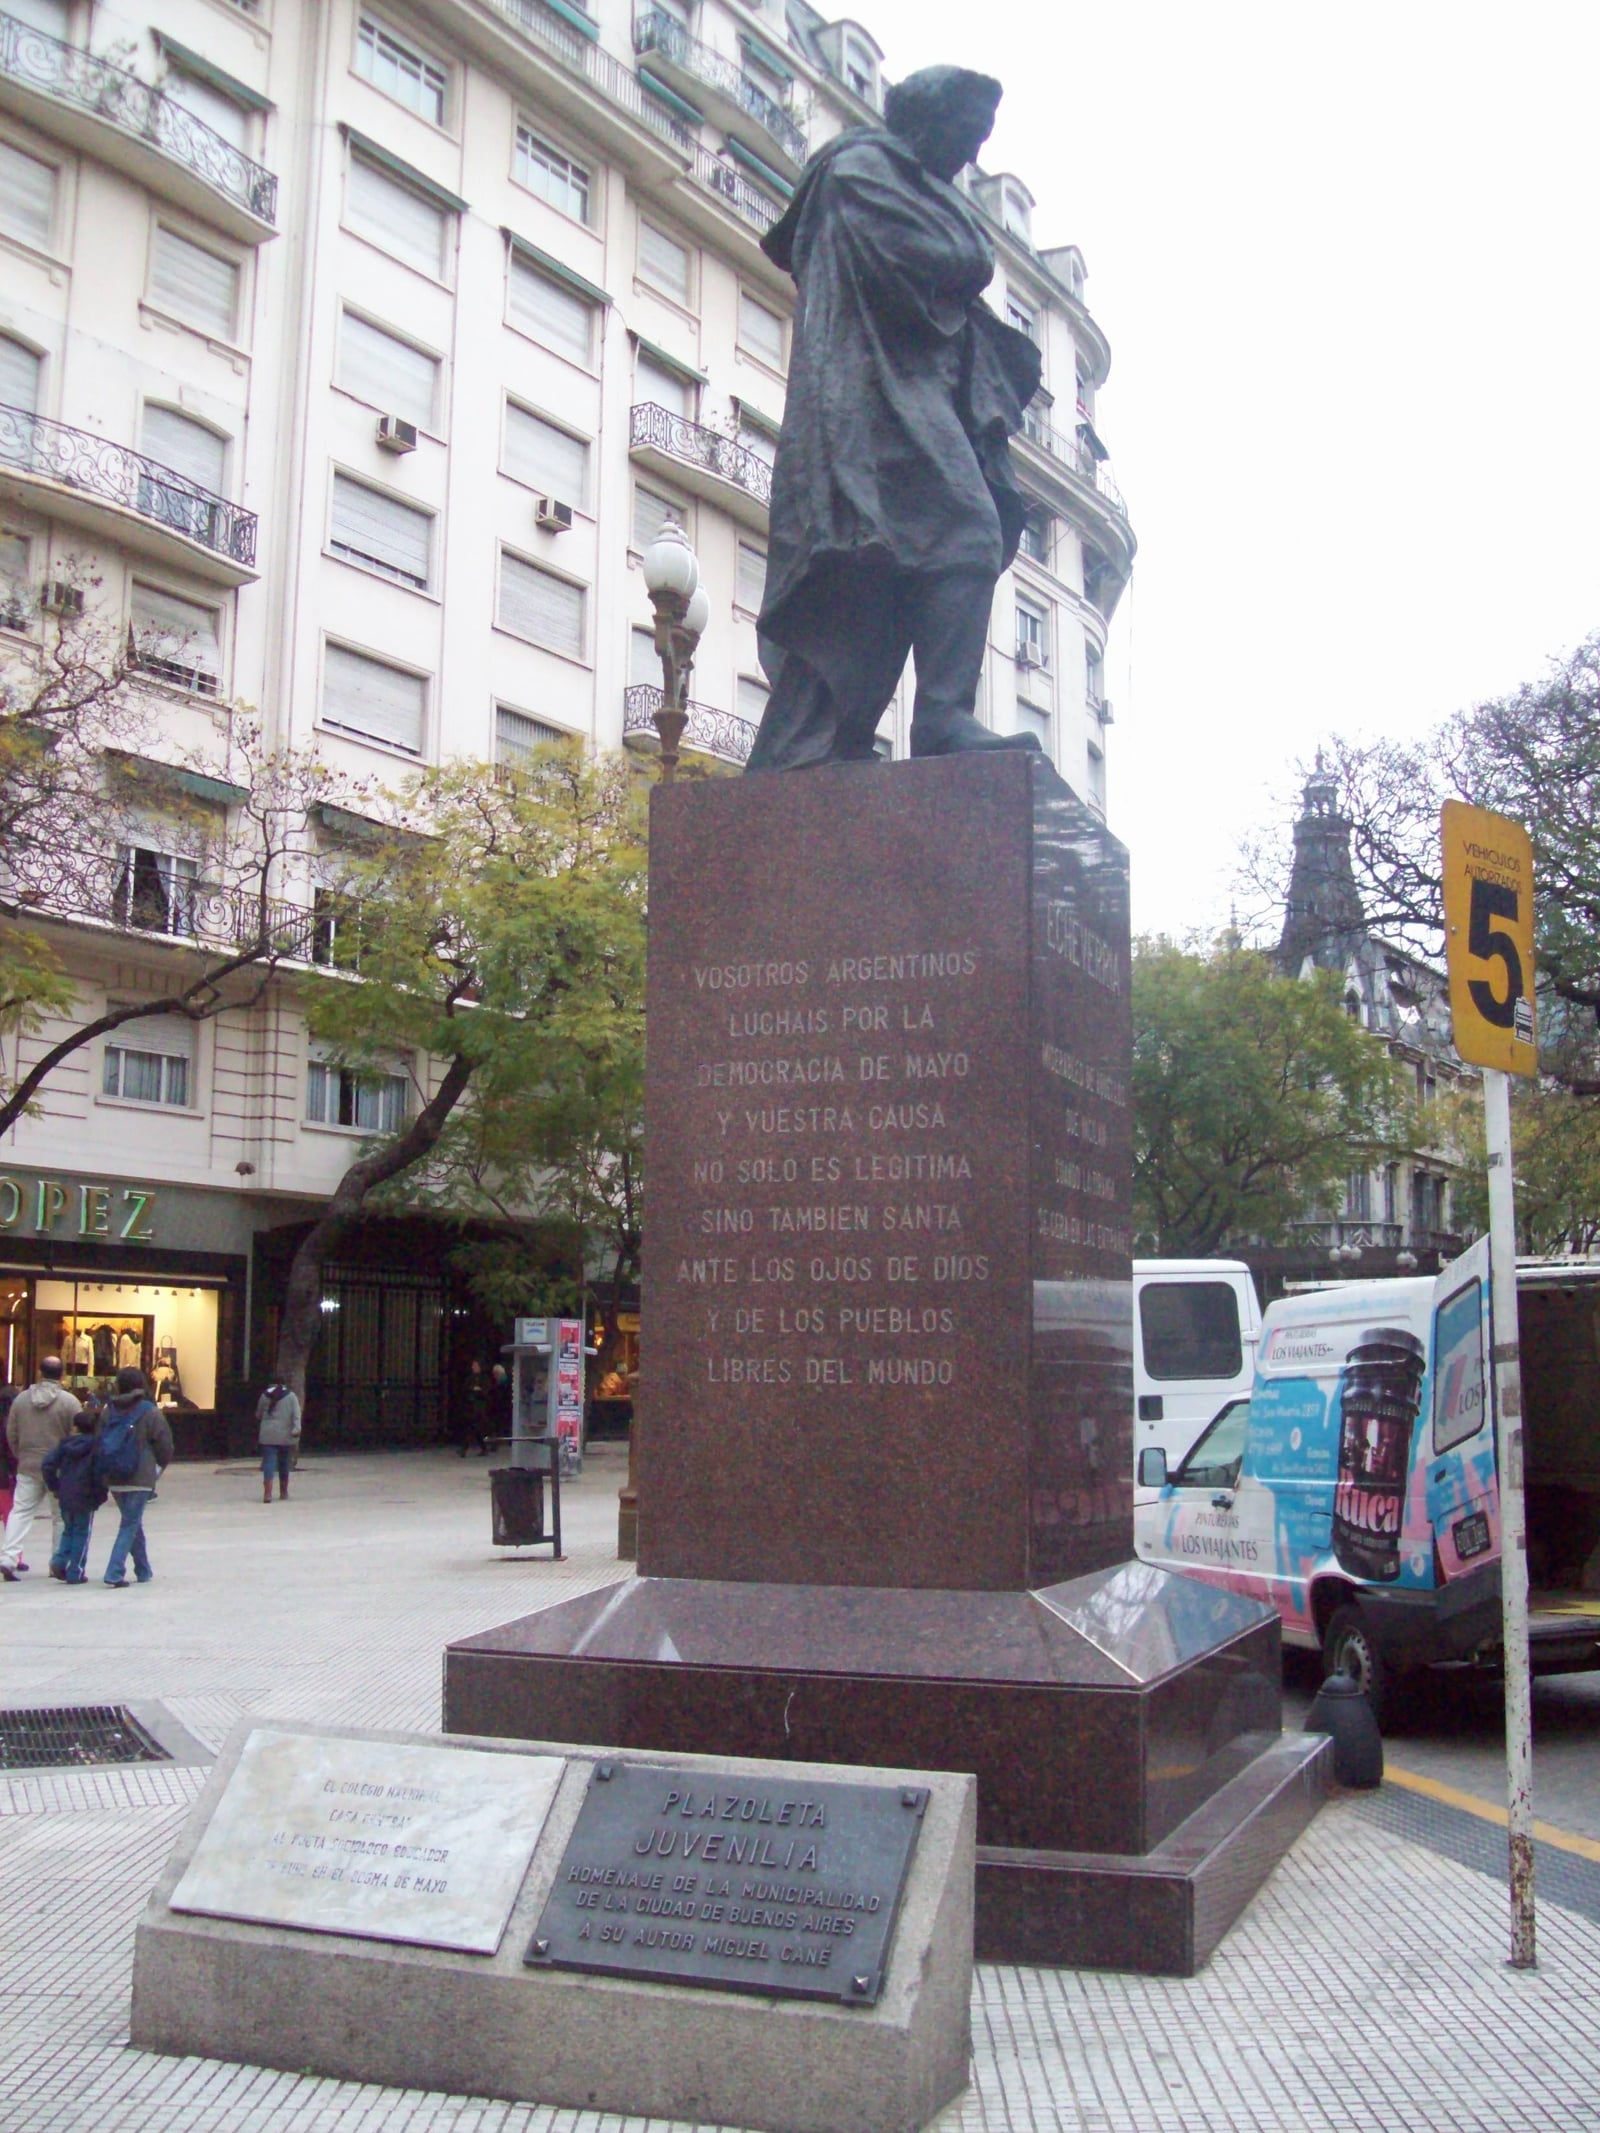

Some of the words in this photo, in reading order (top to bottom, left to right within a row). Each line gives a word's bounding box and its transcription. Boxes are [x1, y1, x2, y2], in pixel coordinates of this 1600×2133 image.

[1462, 840, 1521, 873] VEHICULOS
[1467, 878, 1524, 1028] 5
[694, 961, 808, 989] VOSOTROS
[826, 951, 977, 983] ARGENTINOS
[730, 1008, 829, 1037] LUCHAIS
[842, 1006, 889, 1032] POR
[902, 1003, 936, 1030] LA
[698, 1055, 845, 1087] DEMOCRACIA
[859, 1055, 891, 1081] DE
[905, 1052, 969, 1079] MAYO
[717, 1110, 731, 1136] Y
[745, 1106, 853, 1133] VUESTRA
[868, 1103, 947, 1131] CAUSA
[693, 1161, 724, 1184] NO
[738, 1158, 798, 1183] SOLO
[811, 1157, 841, 1182] ES
[855, 1154, 973, 1181] LEGITIMA
[701, 1208, 754, 1233] SINO
[768, 1206, 870, 1233] TAMBIEN
[882, 1204, 962, 1231] SANTA
[677, 1257, 739, 1283] ANTE
[751, 1257, 797, 1282] LOS
[810, 1256, 873, 1282] OJOS
[887, 1256, 919, 1282] DE
[934, 1255, 990, 1282] DIOS
[707, 1309, 721, 1333] Y
[736, 1309, 766, 1333] DE
[779, 1308, 826, 1333] LOS
[839, 1308, 955, 1334] PUEBLOS
[708, 1358, 793, 1384] LIBRES
[806, 1359, 854, 1385] DEL
[868, 1359, 954, 1385] MUNDO
[1181, 1534, 1201, 1555] LOS
[323, 1779, 336, 1793] EL
[340, 1781, 384, 1798] COLEGIO
[661, 1790, 826, 1828] PLAZOLETA
[634, 1828, 818, 1872] JUVENILIA
[412, 1875, 449, 1895] MAYO
[567, 1864, 664, 1890] HOMENAJE
[672, 1874, 698, 1893] DE
[705, 1877, 731, 1897] LA
[741, 1880, 881, 1914] MUNICIPALIDAD
[576, 1889, 600, 1908] DE
[603, 1893, 628, 1913] LA
[636, 1896, 697, 1919] CIUDAD
[700, 1902, 725, 1923] DE
[728, 1905, 798, 1930] BUENOS
[802, 1913, 856, 1936] AIRES
[579, 1921, 592, 1940] A
[600, 1924, 626, 1944] SU
[633, 1927, 695, 1950] AUTOR
[703, 1936, 770, 1961] MIGUEL
[780, 1941, 833, 1968] CANÉ
